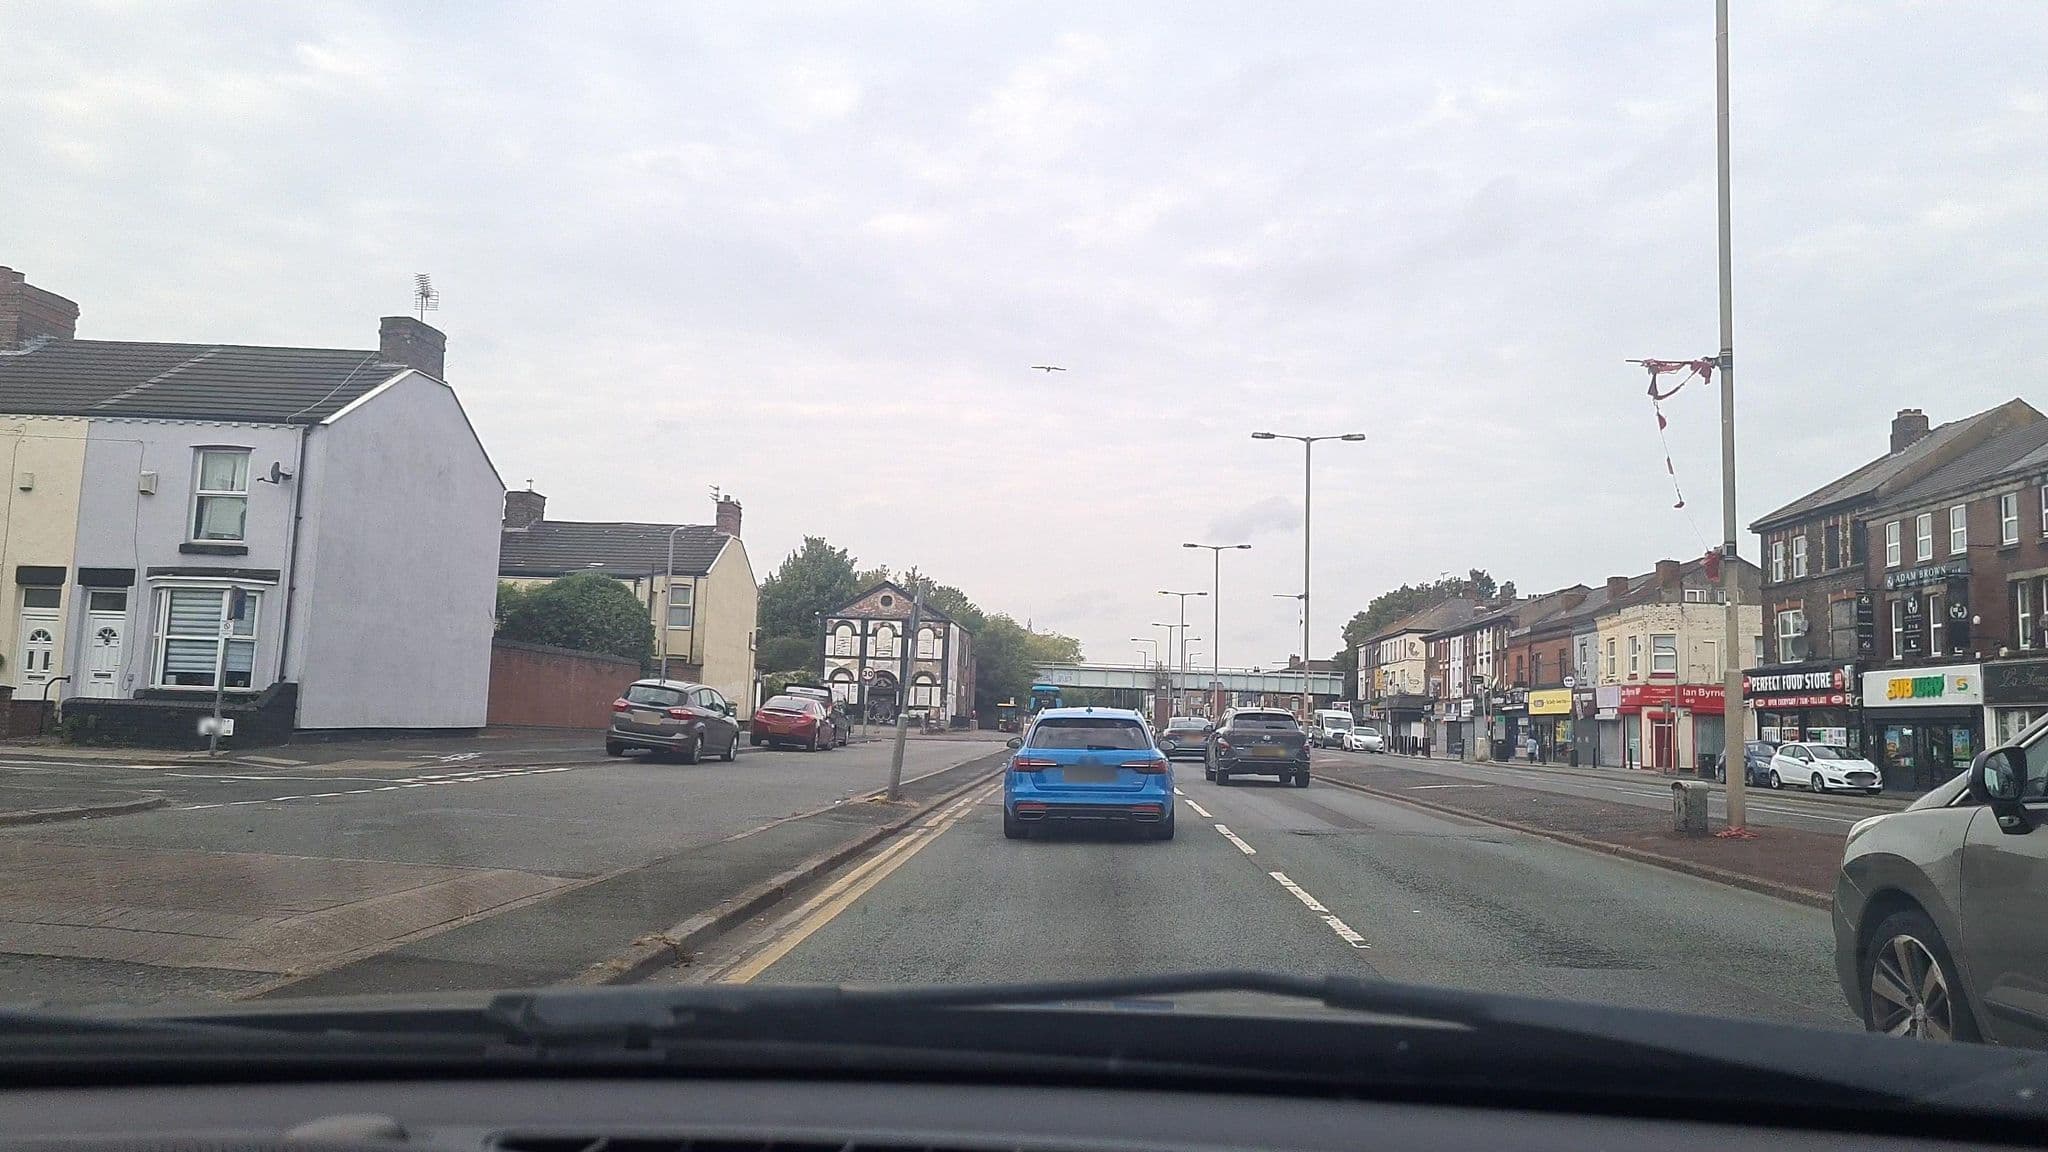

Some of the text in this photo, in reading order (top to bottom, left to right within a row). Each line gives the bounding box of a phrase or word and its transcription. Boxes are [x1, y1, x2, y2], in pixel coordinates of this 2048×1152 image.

[1896, 571, 1916, 583] ADAM
[1919, 565, 1946, 579] BROWN
[1751, 675, 1780, 692] PERFECT
[1782, 674, 1803, 690] FOOD
[1804, 672, 1831, 689] STORE
[1683, 688, 1697, 696] Ian
